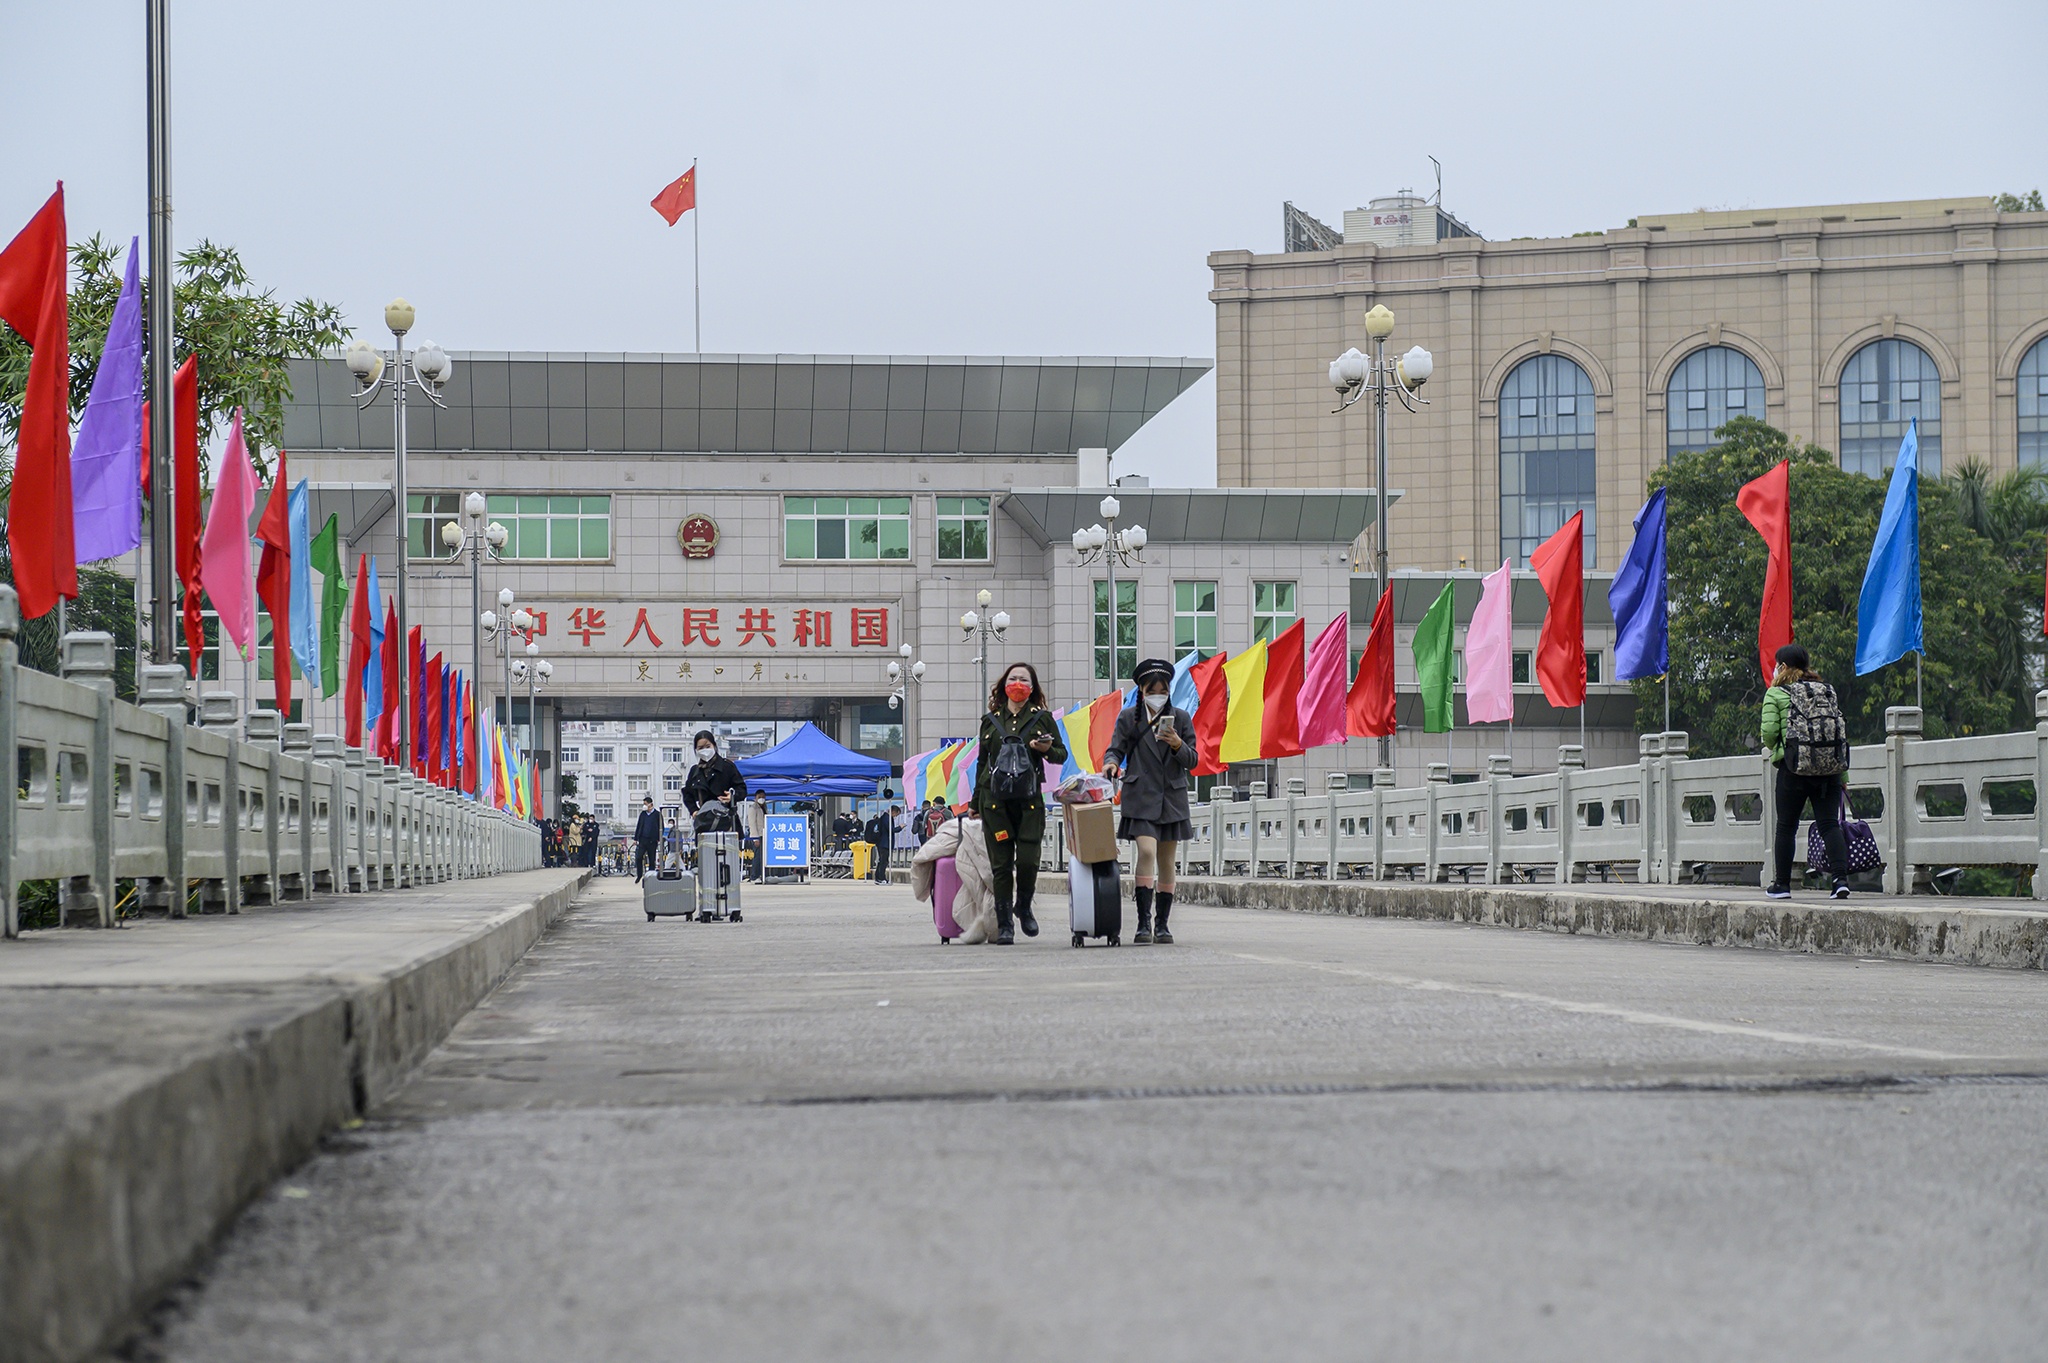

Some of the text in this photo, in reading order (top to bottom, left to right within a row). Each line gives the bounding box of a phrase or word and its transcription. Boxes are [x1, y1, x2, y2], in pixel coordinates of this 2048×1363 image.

[511, 607, 889, 648] 中华人民共和国
[770, 823, 804, 833] 入境人员
[773, 837, 800, 851] 通道
